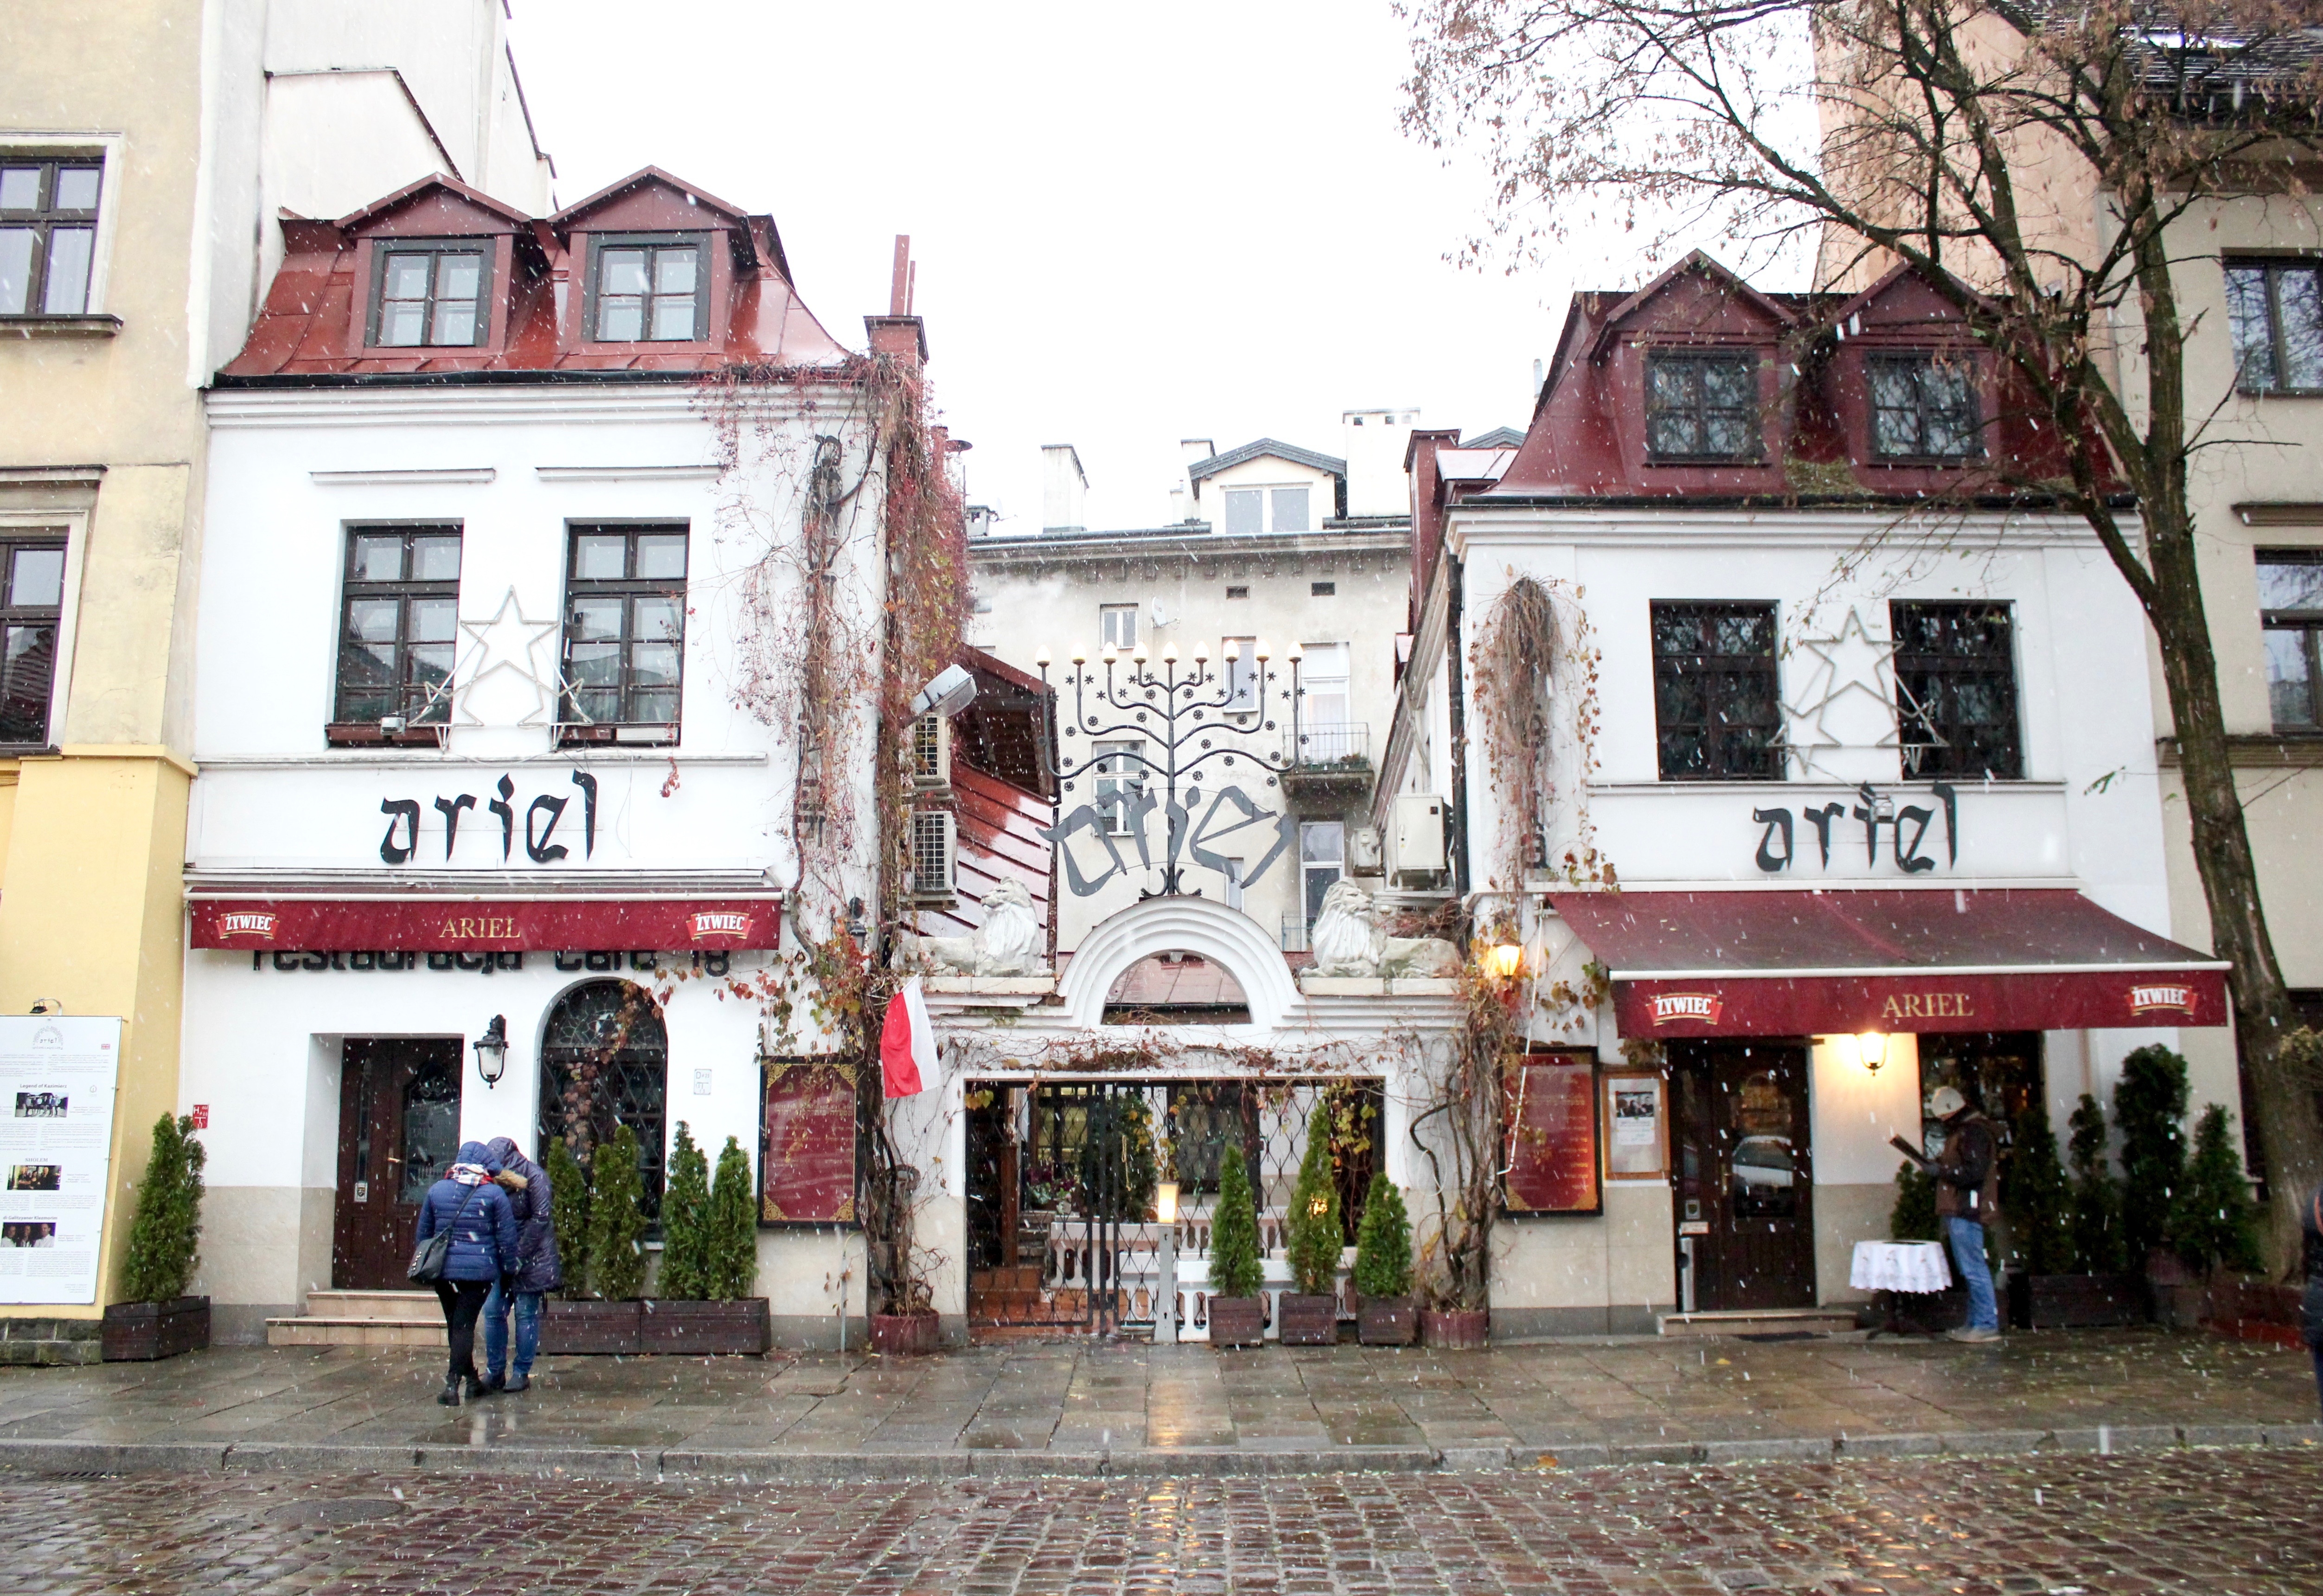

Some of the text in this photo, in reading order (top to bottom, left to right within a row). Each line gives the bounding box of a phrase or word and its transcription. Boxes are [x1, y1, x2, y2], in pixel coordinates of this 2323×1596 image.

[380, 768, 597, 863] ariel
[1753, 779, 1958, 873] ariel
[225, 913, 274, 931] ŻYWIEC
[439, 918, 520, 938] ARIEL
[696, 913, 745, 931] ŻYWIEC
[1655, 995, 1712, 1016] ŻYWIEC
[1881, 993, 1974, 1018] ARIEL
[2132, 985, 2187, 1006] ŻYWIEC
